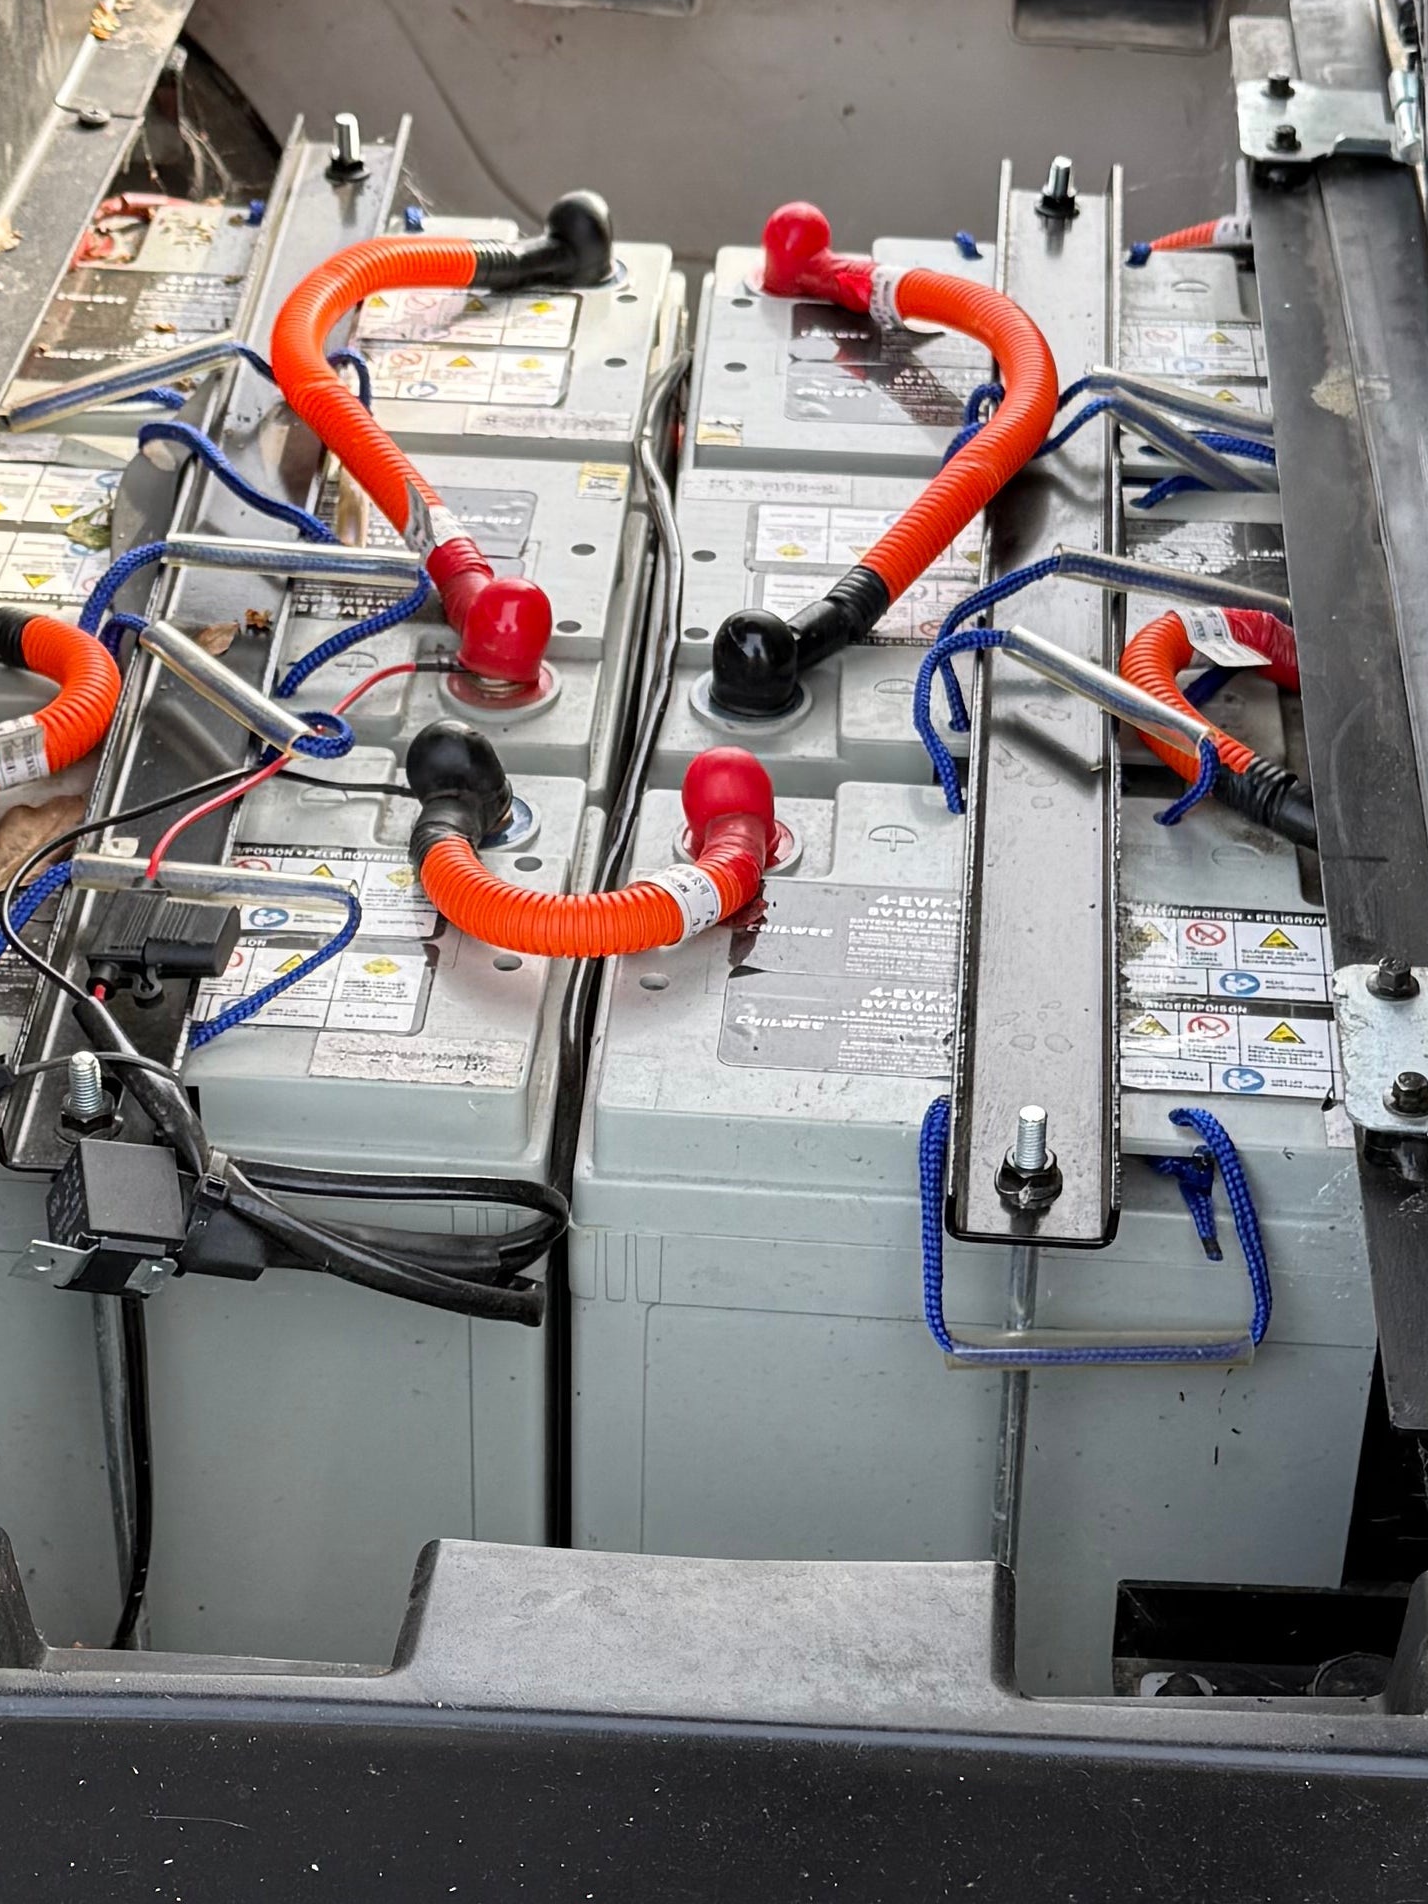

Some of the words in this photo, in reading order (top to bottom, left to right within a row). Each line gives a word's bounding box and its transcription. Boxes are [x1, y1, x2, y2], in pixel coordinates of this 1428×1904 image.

[305, 849, 409, 862] PELIGRO/VENEN
[875, 895, 961, 909] 4-EVF-1
[1255, 913, 1325, 925] PELIGRO/V
[747, 923, 834, 938] CHILWEE
[869, 987, 956, 1003] 4-EVF-1
[1141, 1001, 1247, 1014] ANGER/POISON
[735, 1015, 825, 1031] CHILWEE
